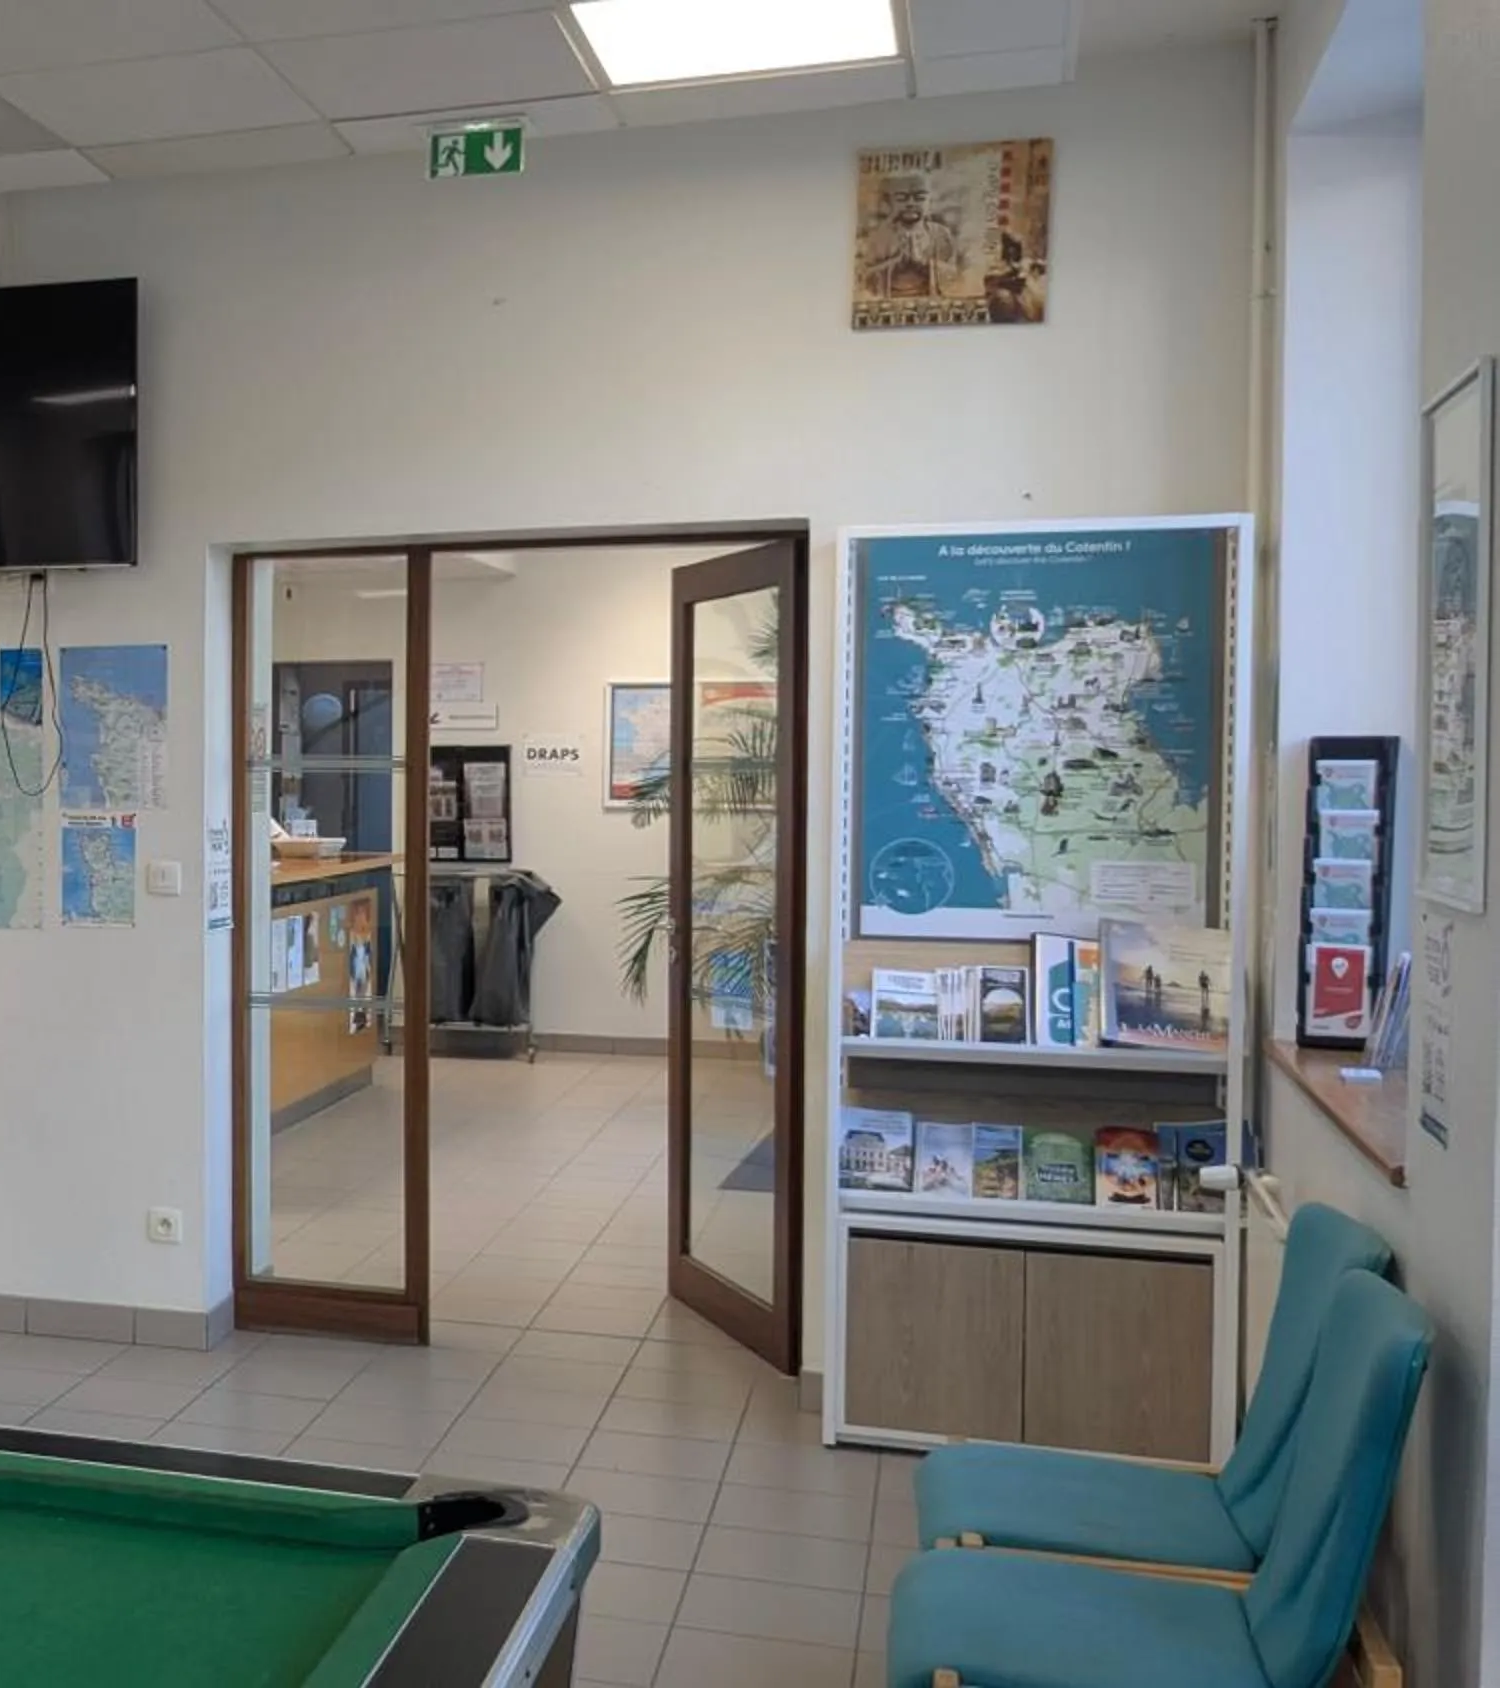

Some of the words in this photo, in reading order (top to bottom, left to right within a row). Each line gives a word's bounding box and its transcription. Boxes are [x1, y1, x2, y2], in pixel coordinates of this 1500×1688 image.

[938, 545, 948, 557] A
[951, 544, 964, 556] la
[967, 543, 1041, 556] découverte
[1044, 542, 1063, 554] du
[1065, 540, 1122, 554] Cotentin
[527, 748, 580, 761] DRAPS
